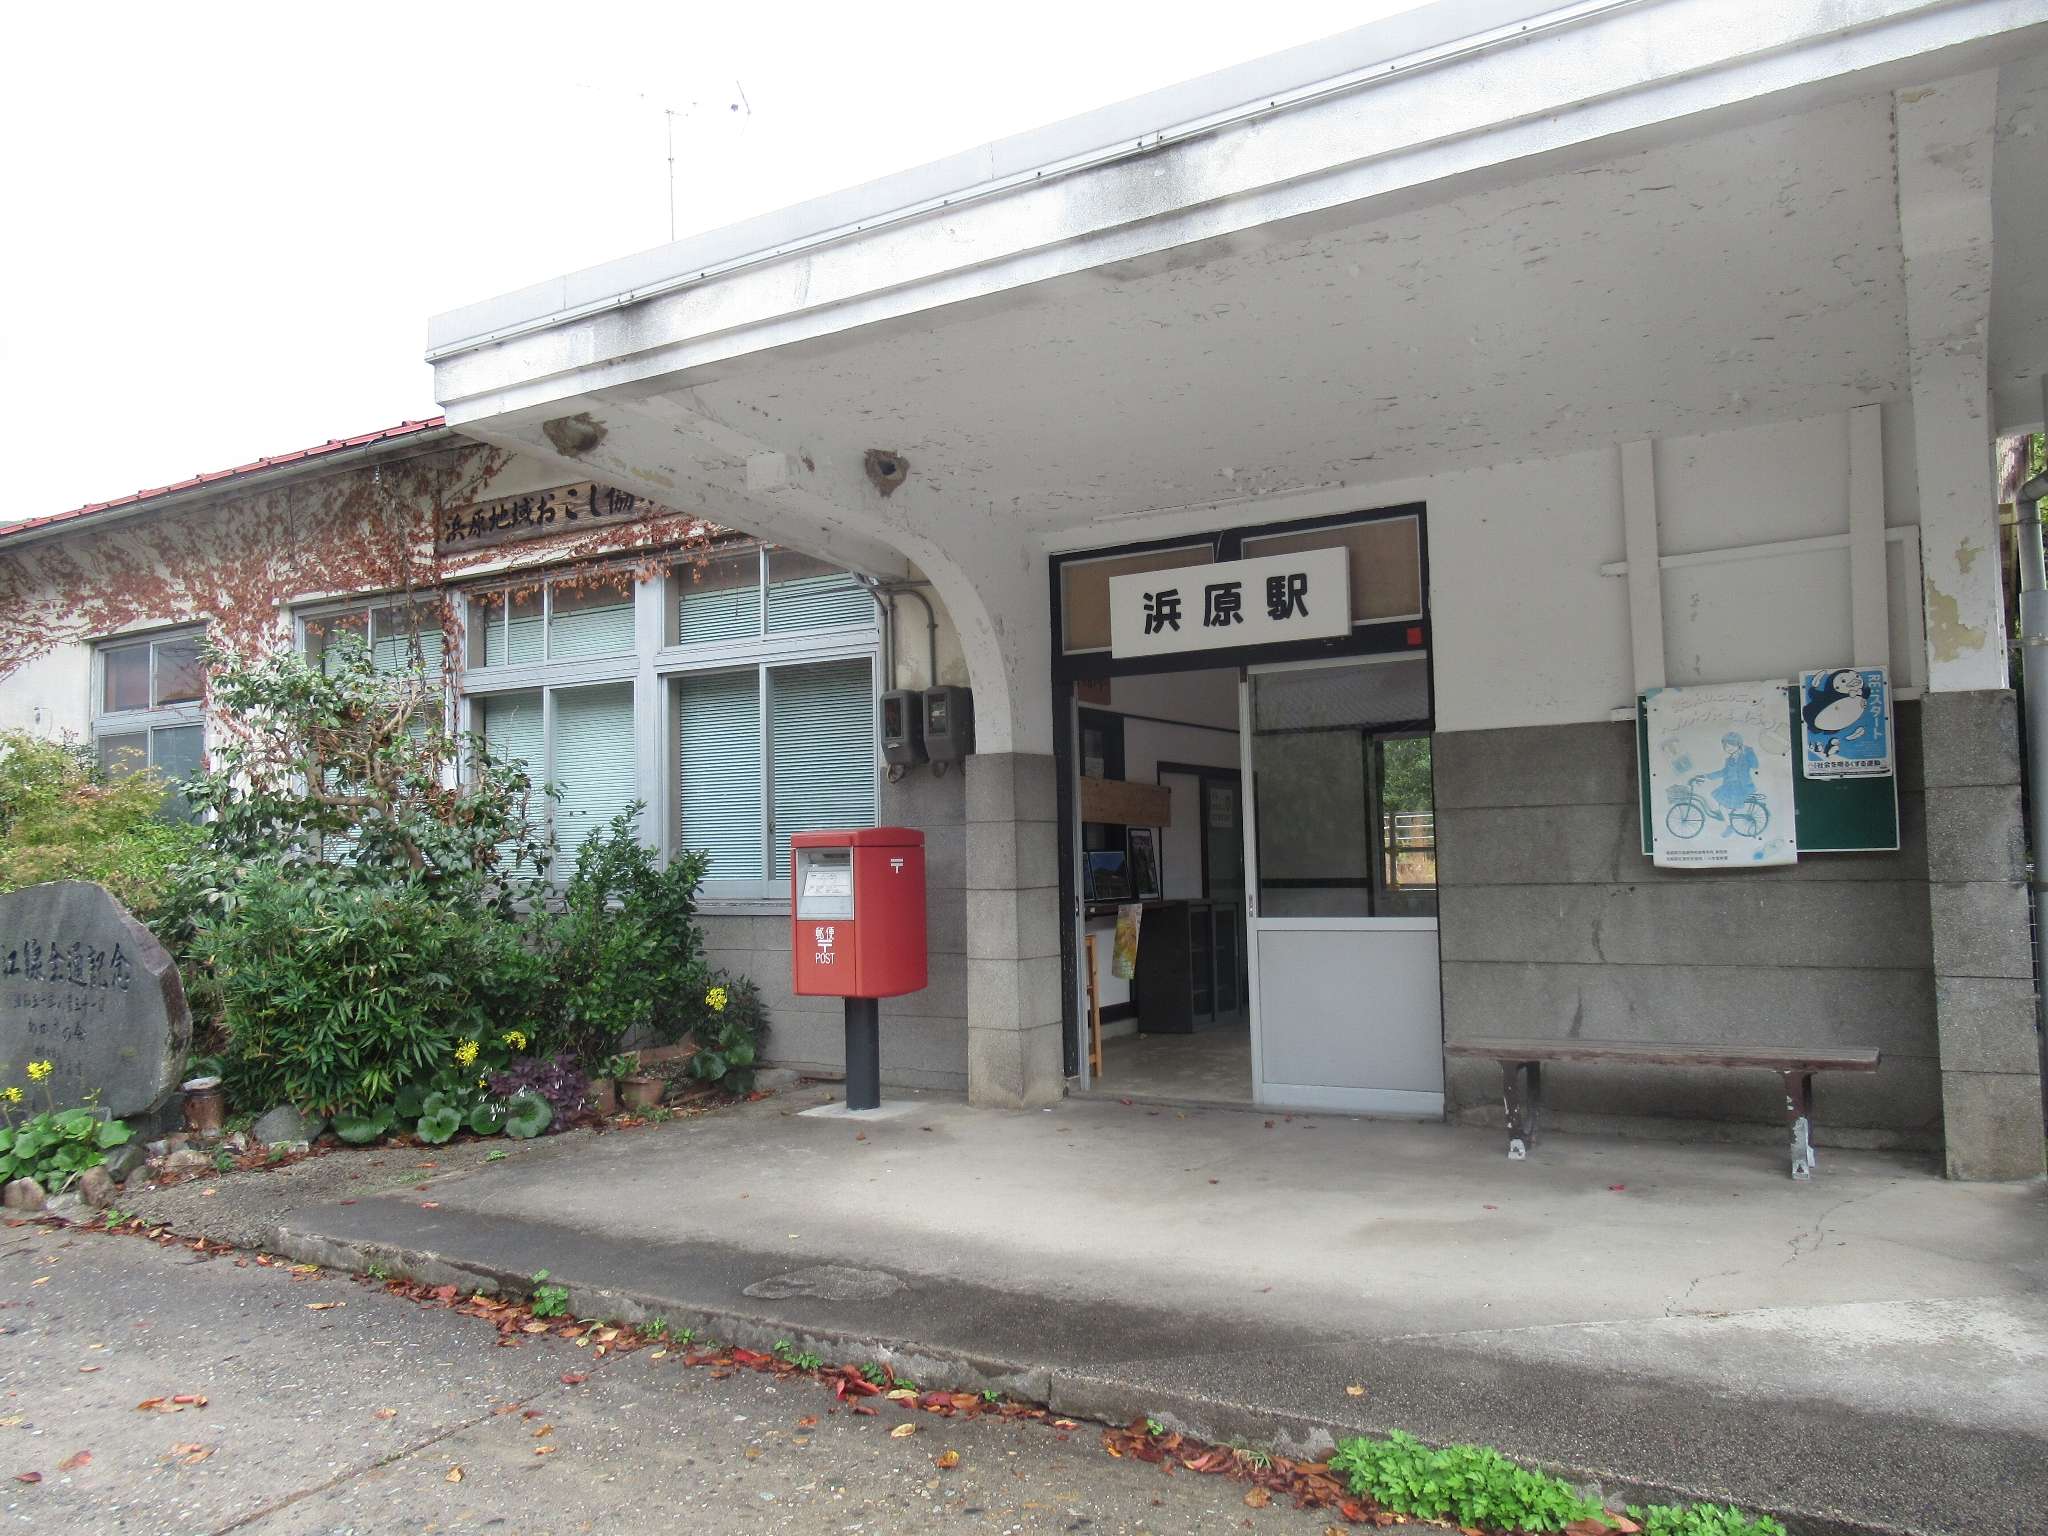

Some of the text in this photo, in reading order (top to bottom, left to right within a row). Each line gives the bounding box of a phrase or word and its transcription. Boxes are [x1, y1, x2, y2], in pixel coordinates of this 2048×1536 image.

[445, 484, 655, 544] 浜原地域おこし協
[1143, 573, 1309, 635] 浜原駅
[815, 926, 835, 940] 郵便
[815, 952, 835, 965] POST
